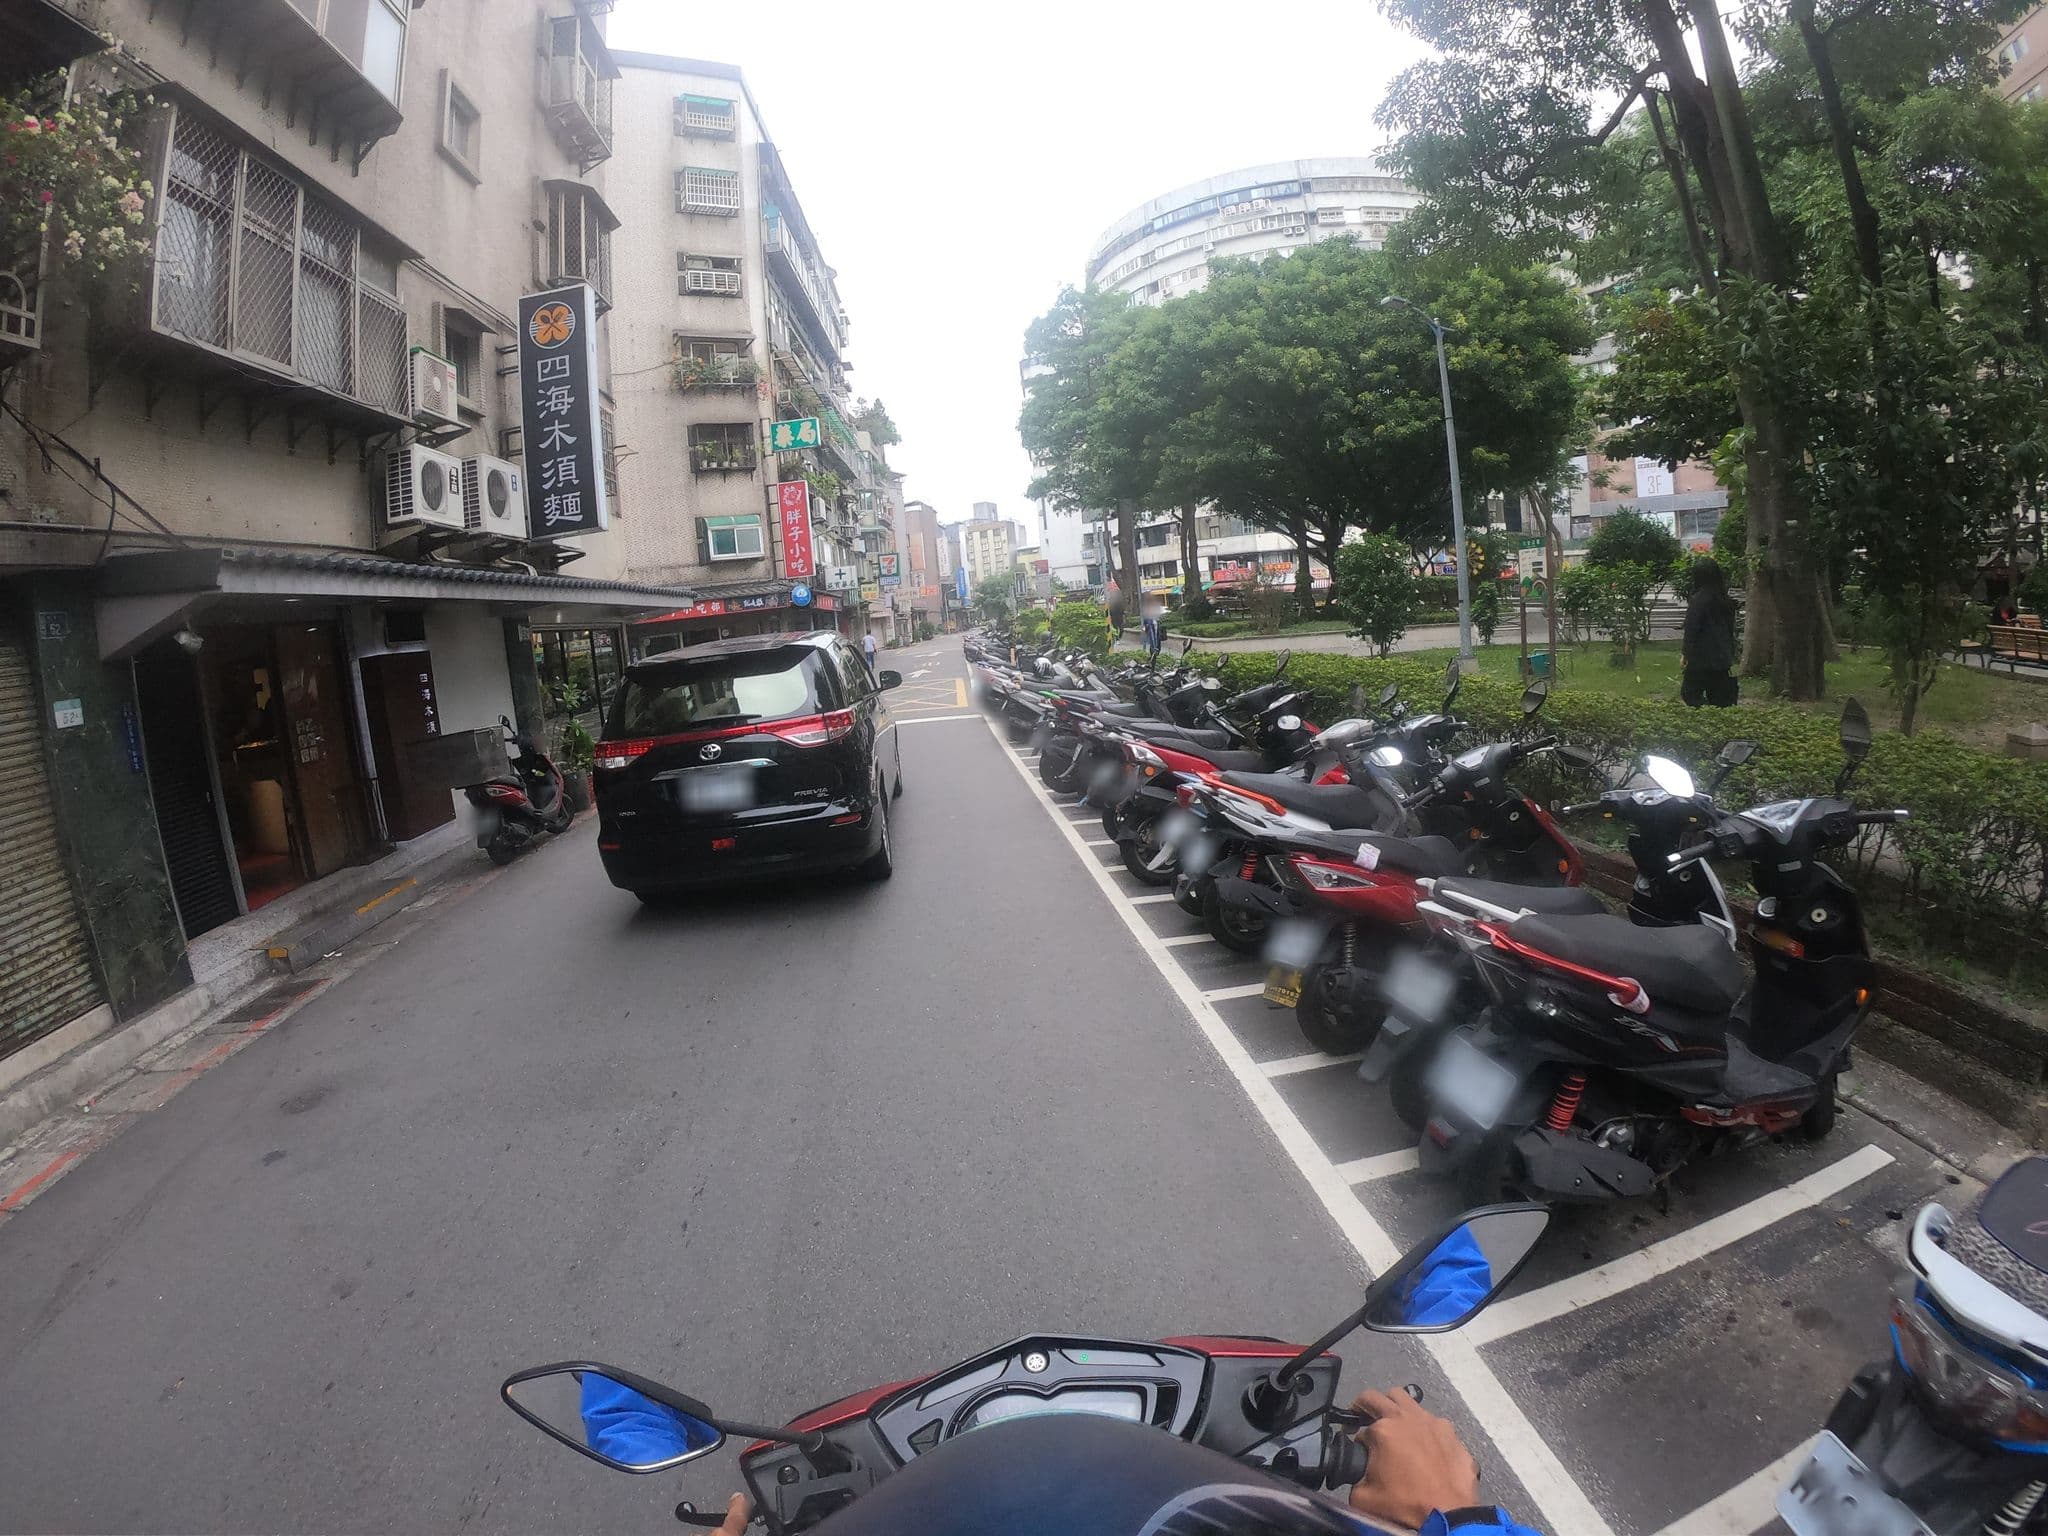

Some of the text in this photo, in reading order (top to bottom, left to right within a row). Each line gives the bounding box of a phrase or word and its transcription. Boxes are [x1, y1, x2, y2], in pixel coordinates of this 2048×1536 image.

[536, 354, 584, 527] 四海木須麵
[786, 509, 808, 573] 胖子小吃
[793, 787, 829, 797] PREVIA
